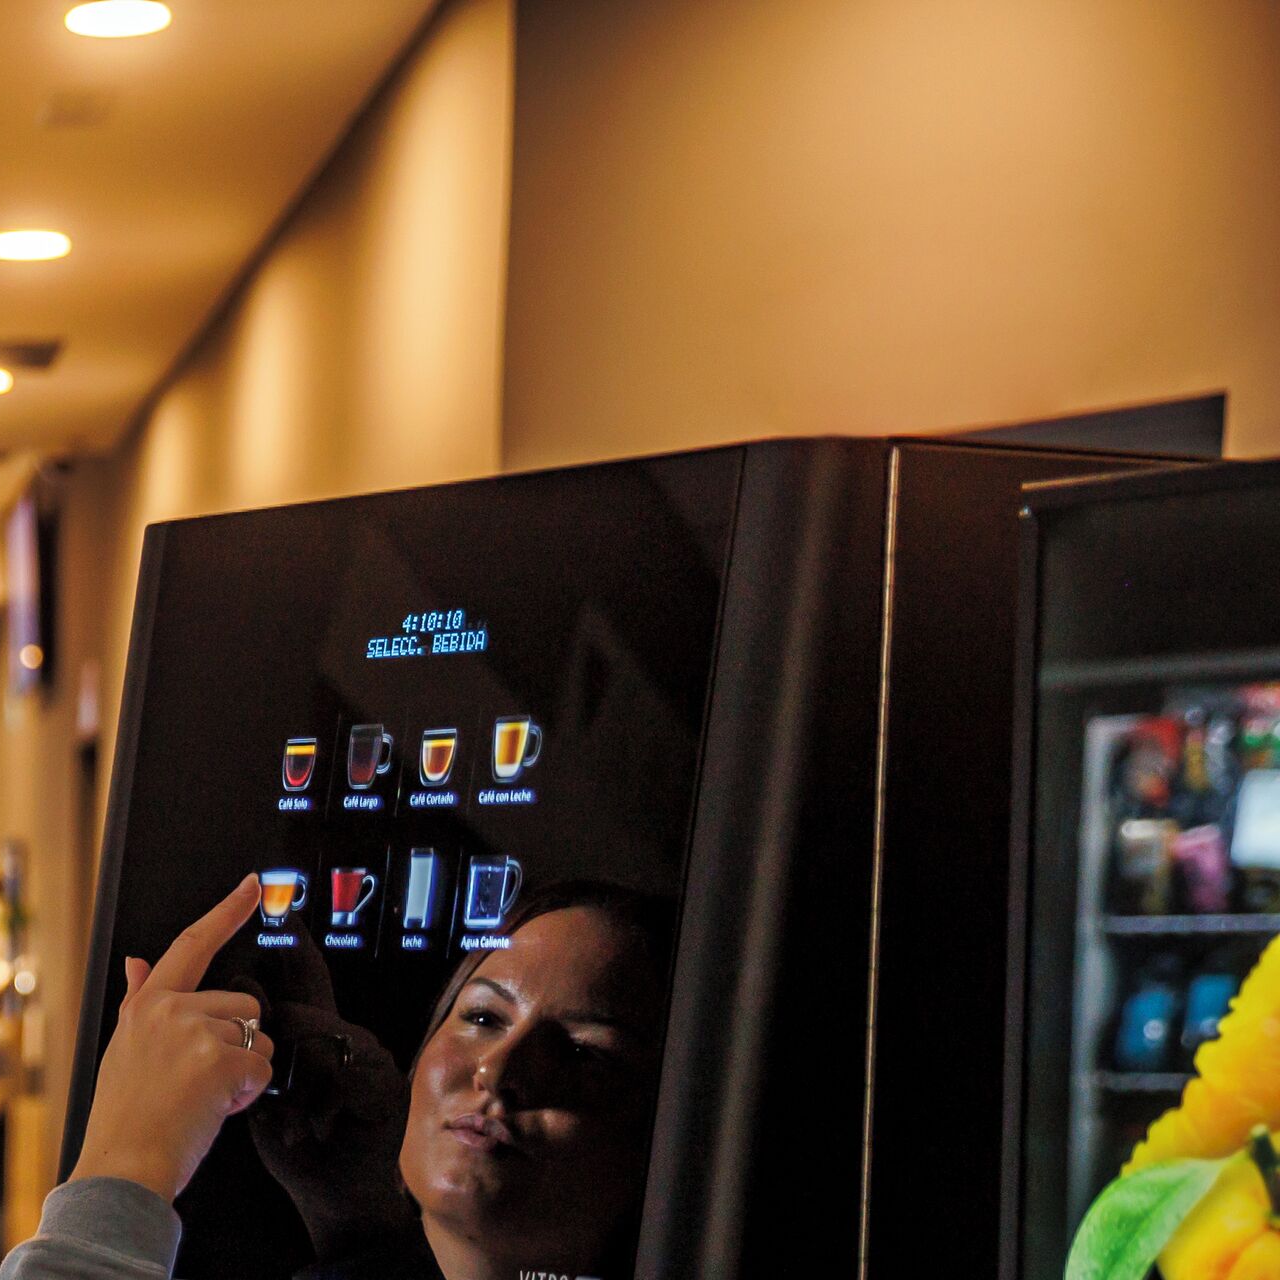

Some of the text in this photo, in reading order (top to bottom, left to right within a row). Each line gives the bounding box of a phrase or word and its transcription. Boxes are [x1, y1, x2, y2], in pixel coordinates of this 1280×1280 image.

[402, 610, 463, 633] 4:10:10
[366, 631, 485, 658] SELECC. BEBIDA
[343, 796, 378, 810] Café Largo
[409, 792, 454, 806] Café Cortado
[479, 789, 531, 804] Café con Leche
[278, 798, 308, 810] Café Solo
[257, 933, 294, 947] Cappuccino
[324, 934, 358, 947] Chocolate
[402, 935, 422, 948] Leche
[460, 936, 509, 950] Agua Caliente
